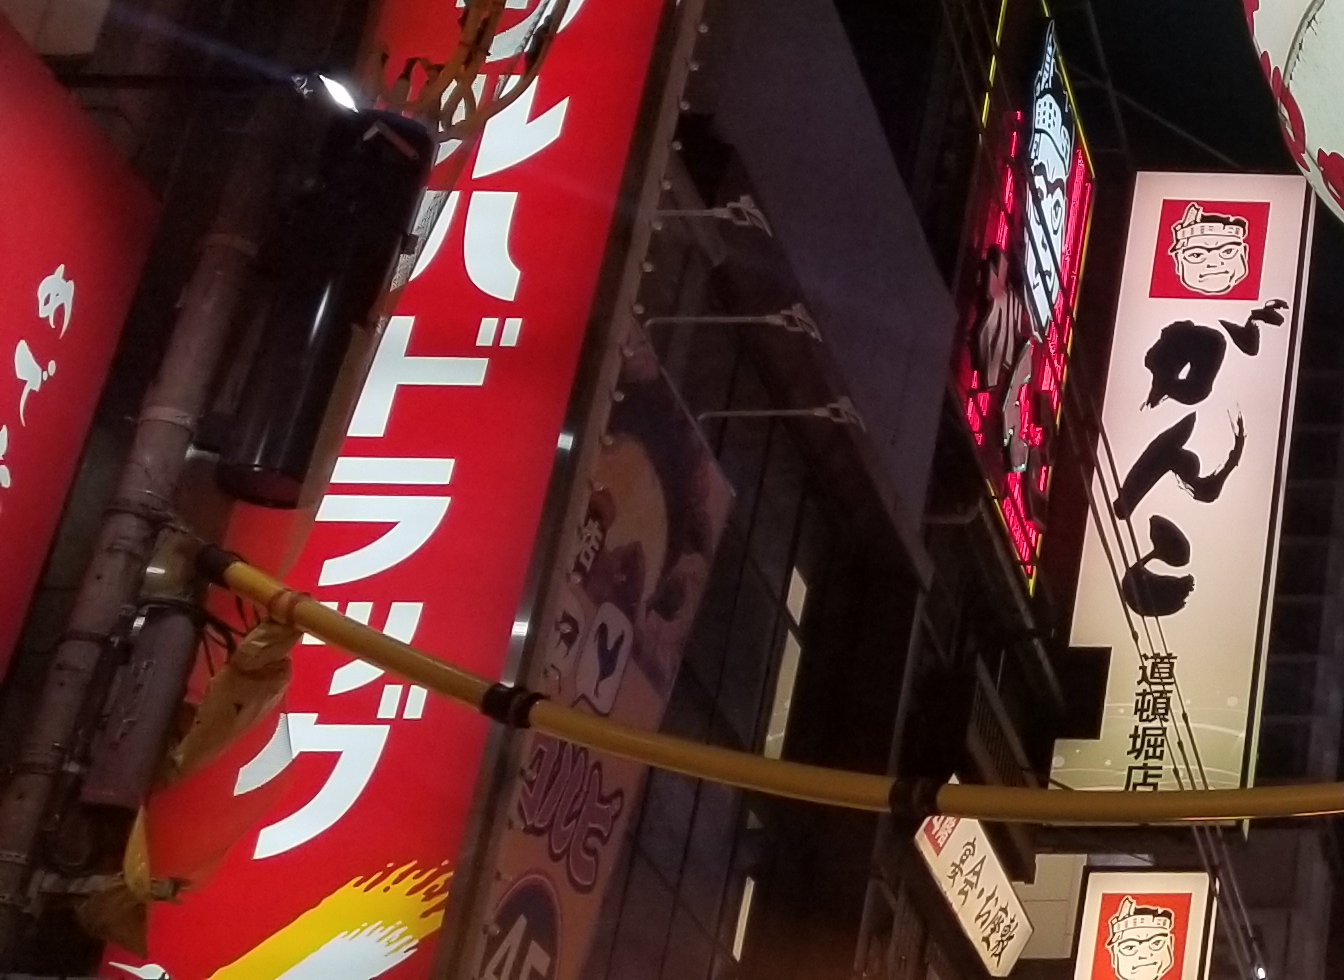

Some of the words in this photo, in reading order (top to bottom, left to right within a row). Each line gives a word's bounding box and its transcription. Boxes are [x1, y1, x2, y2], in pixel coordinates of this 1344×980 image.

[1112, 298, 1290, 617] がんこ
[1122, 652, 1179, 792] 道頓堀店
